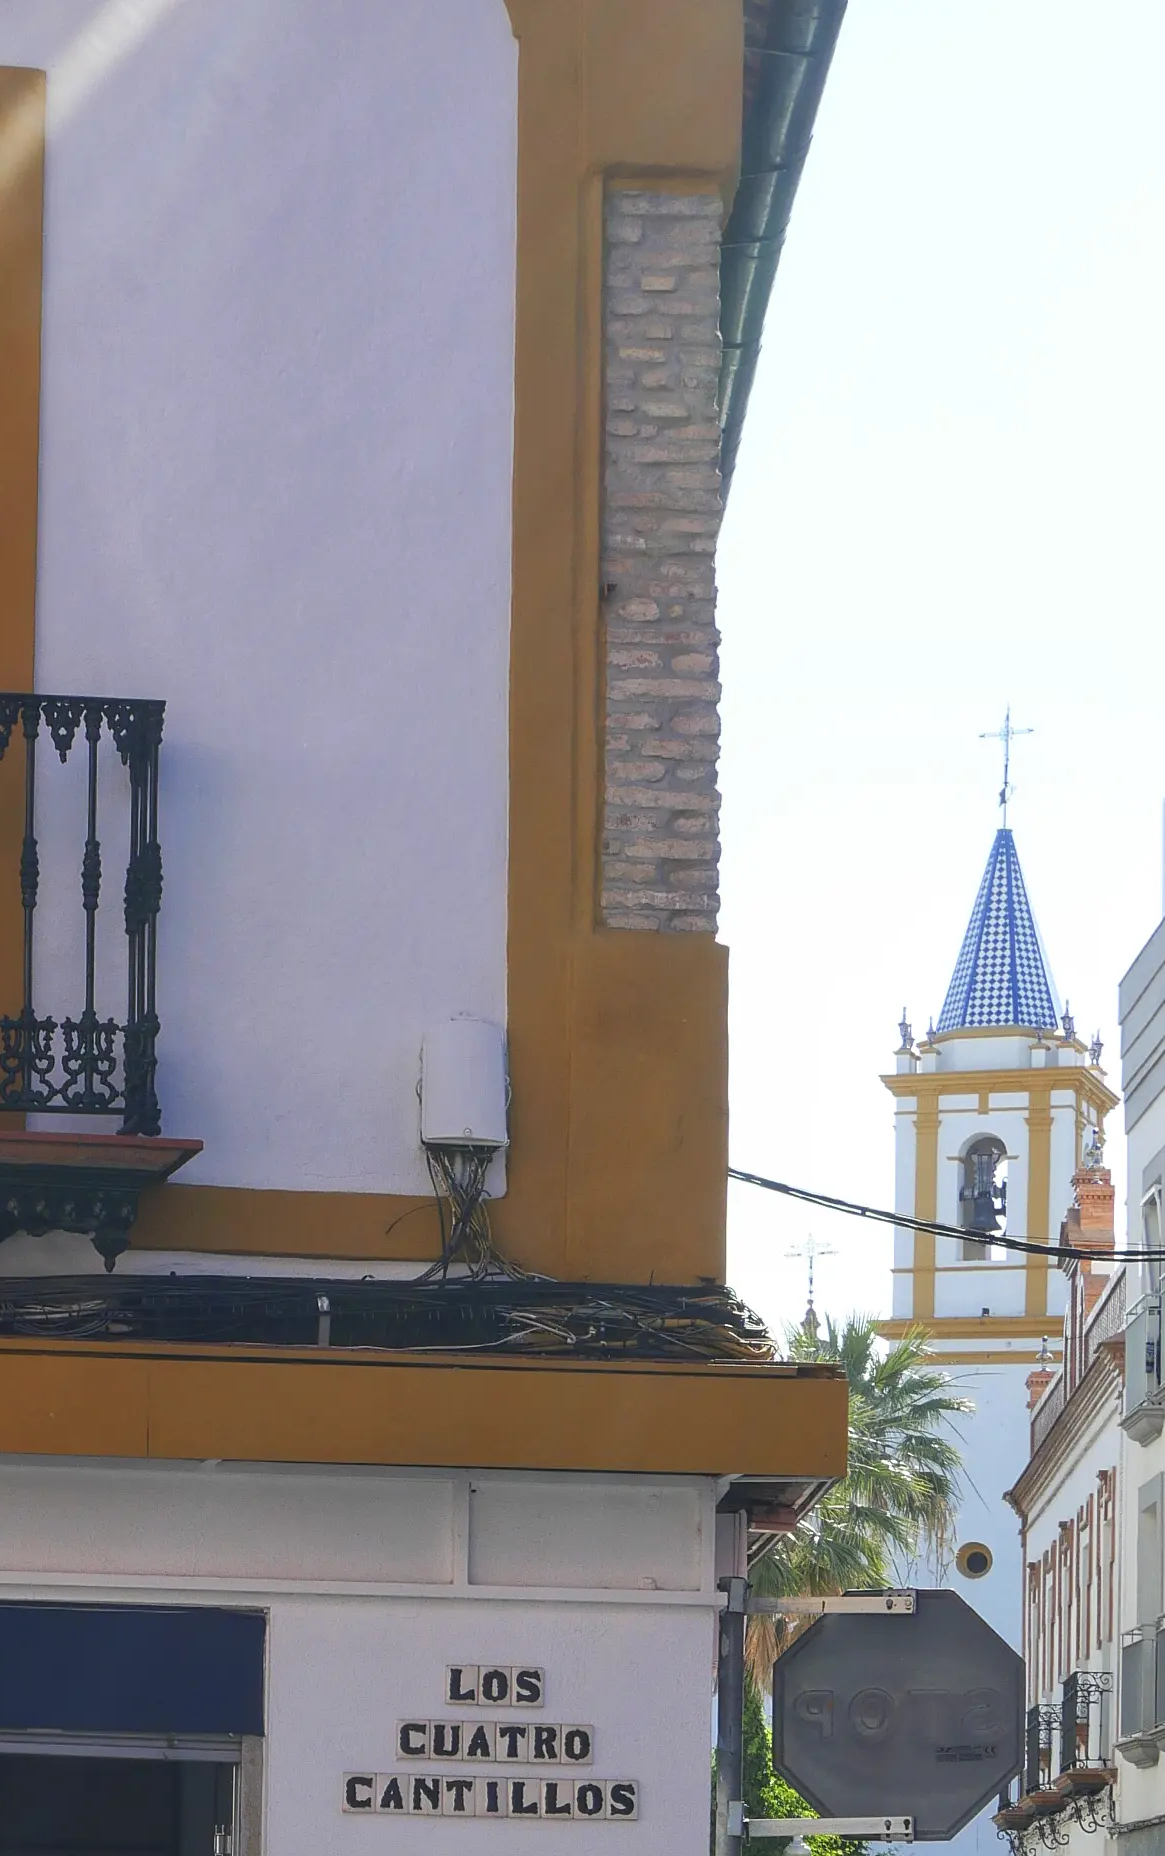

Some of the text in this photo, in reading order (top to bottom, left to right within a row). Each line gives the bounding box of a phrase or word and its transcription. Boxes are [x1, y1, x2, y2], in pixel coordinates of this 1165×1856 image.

[449, 1667, 542, 1703] LOS
[398, 1722, 591, 1761] CUATRO
[345, 1775, 636, 1817] CANTILLOS
